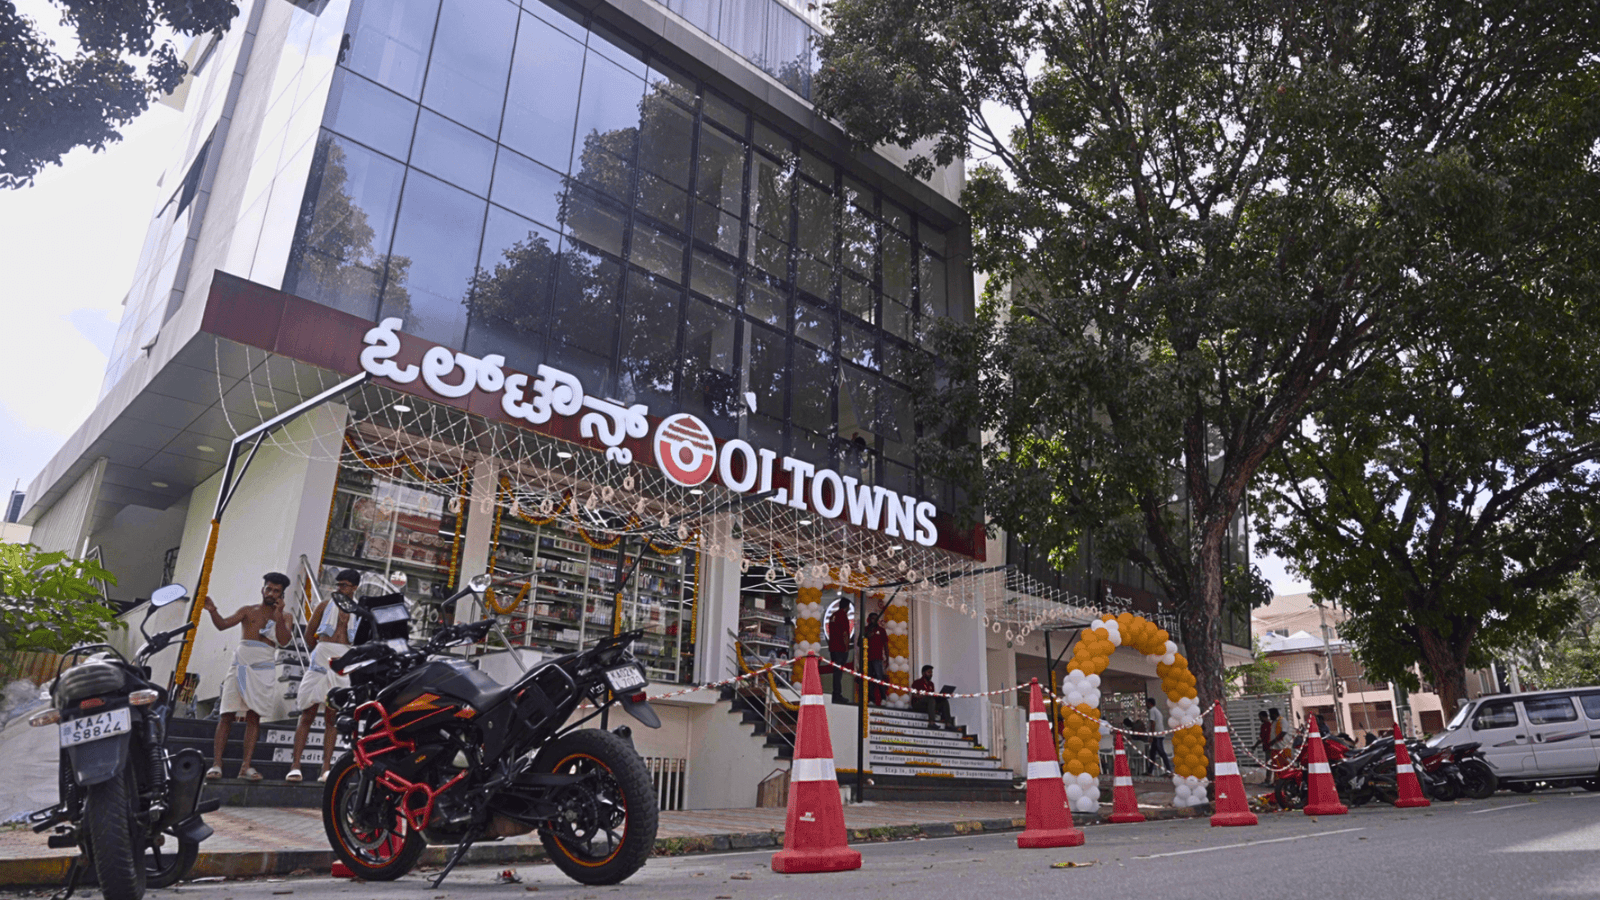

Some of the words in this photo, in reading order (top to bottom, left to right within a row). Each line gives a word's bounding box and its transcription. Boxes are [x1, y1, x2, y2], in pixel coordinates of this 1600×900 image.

[719, 437, 938, 547] OLTOWNS
[73, 721, 121, 742] S8844
[75, 712, 112, 731] KA41
